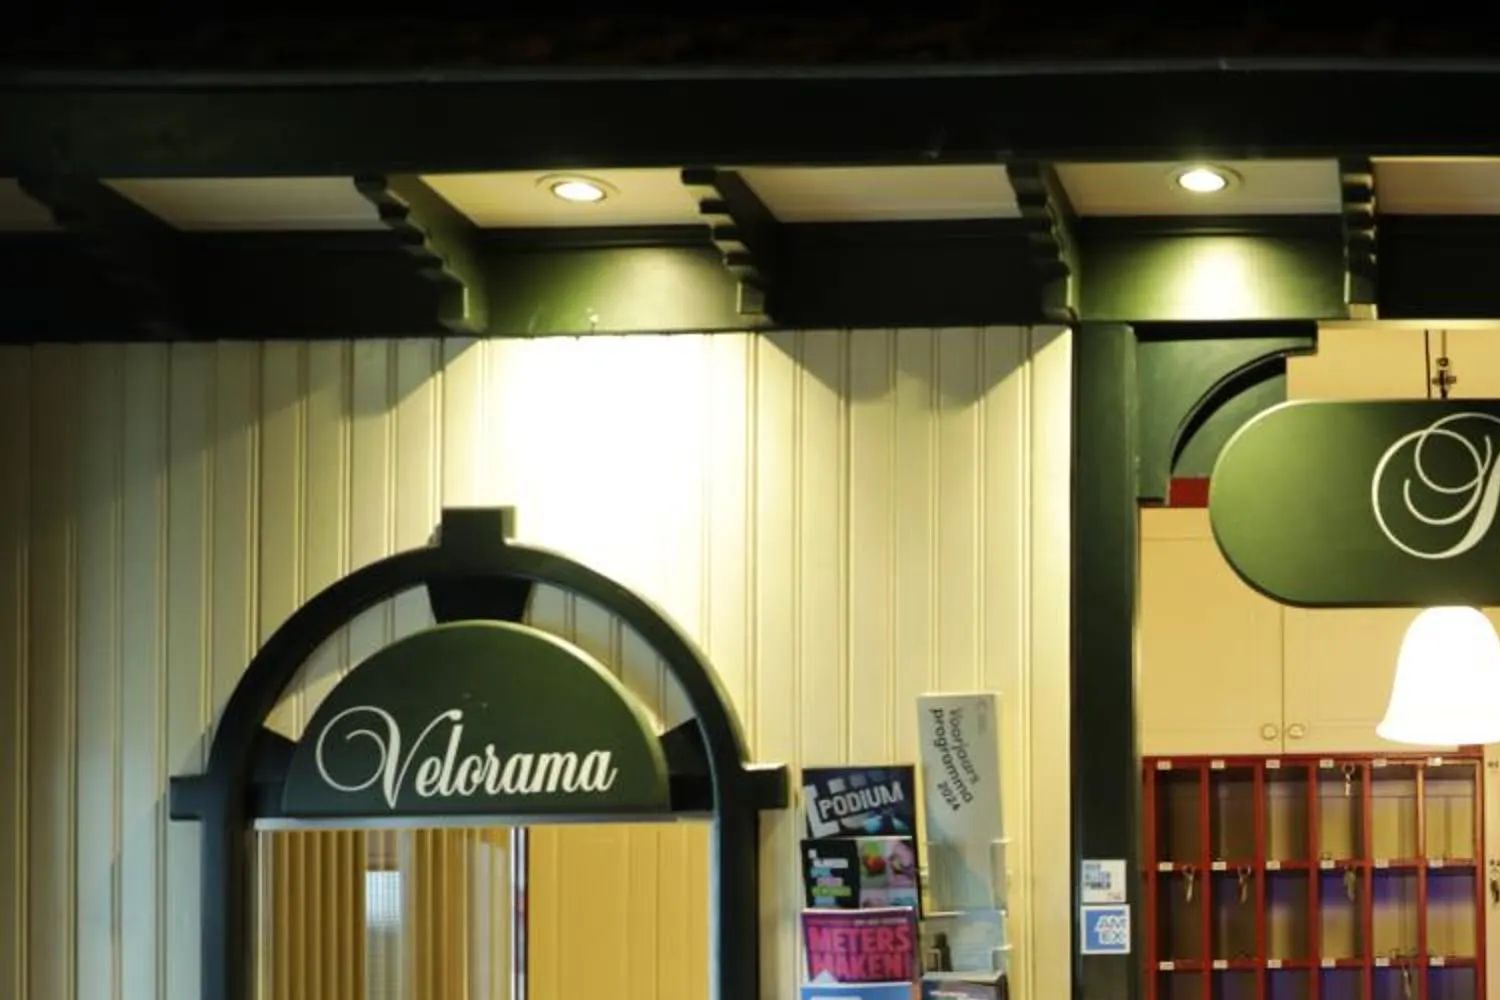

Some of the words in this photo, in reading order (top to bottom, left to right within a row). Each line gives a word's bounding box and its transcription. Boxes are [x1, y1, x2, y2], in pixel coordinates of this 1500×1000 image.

[315, 705, 619, 810] Velorama
[928, 707, 974, 804] programma
[818, 780, 905, 821] PODIUM
[809, 926, 912, 953] METERS
